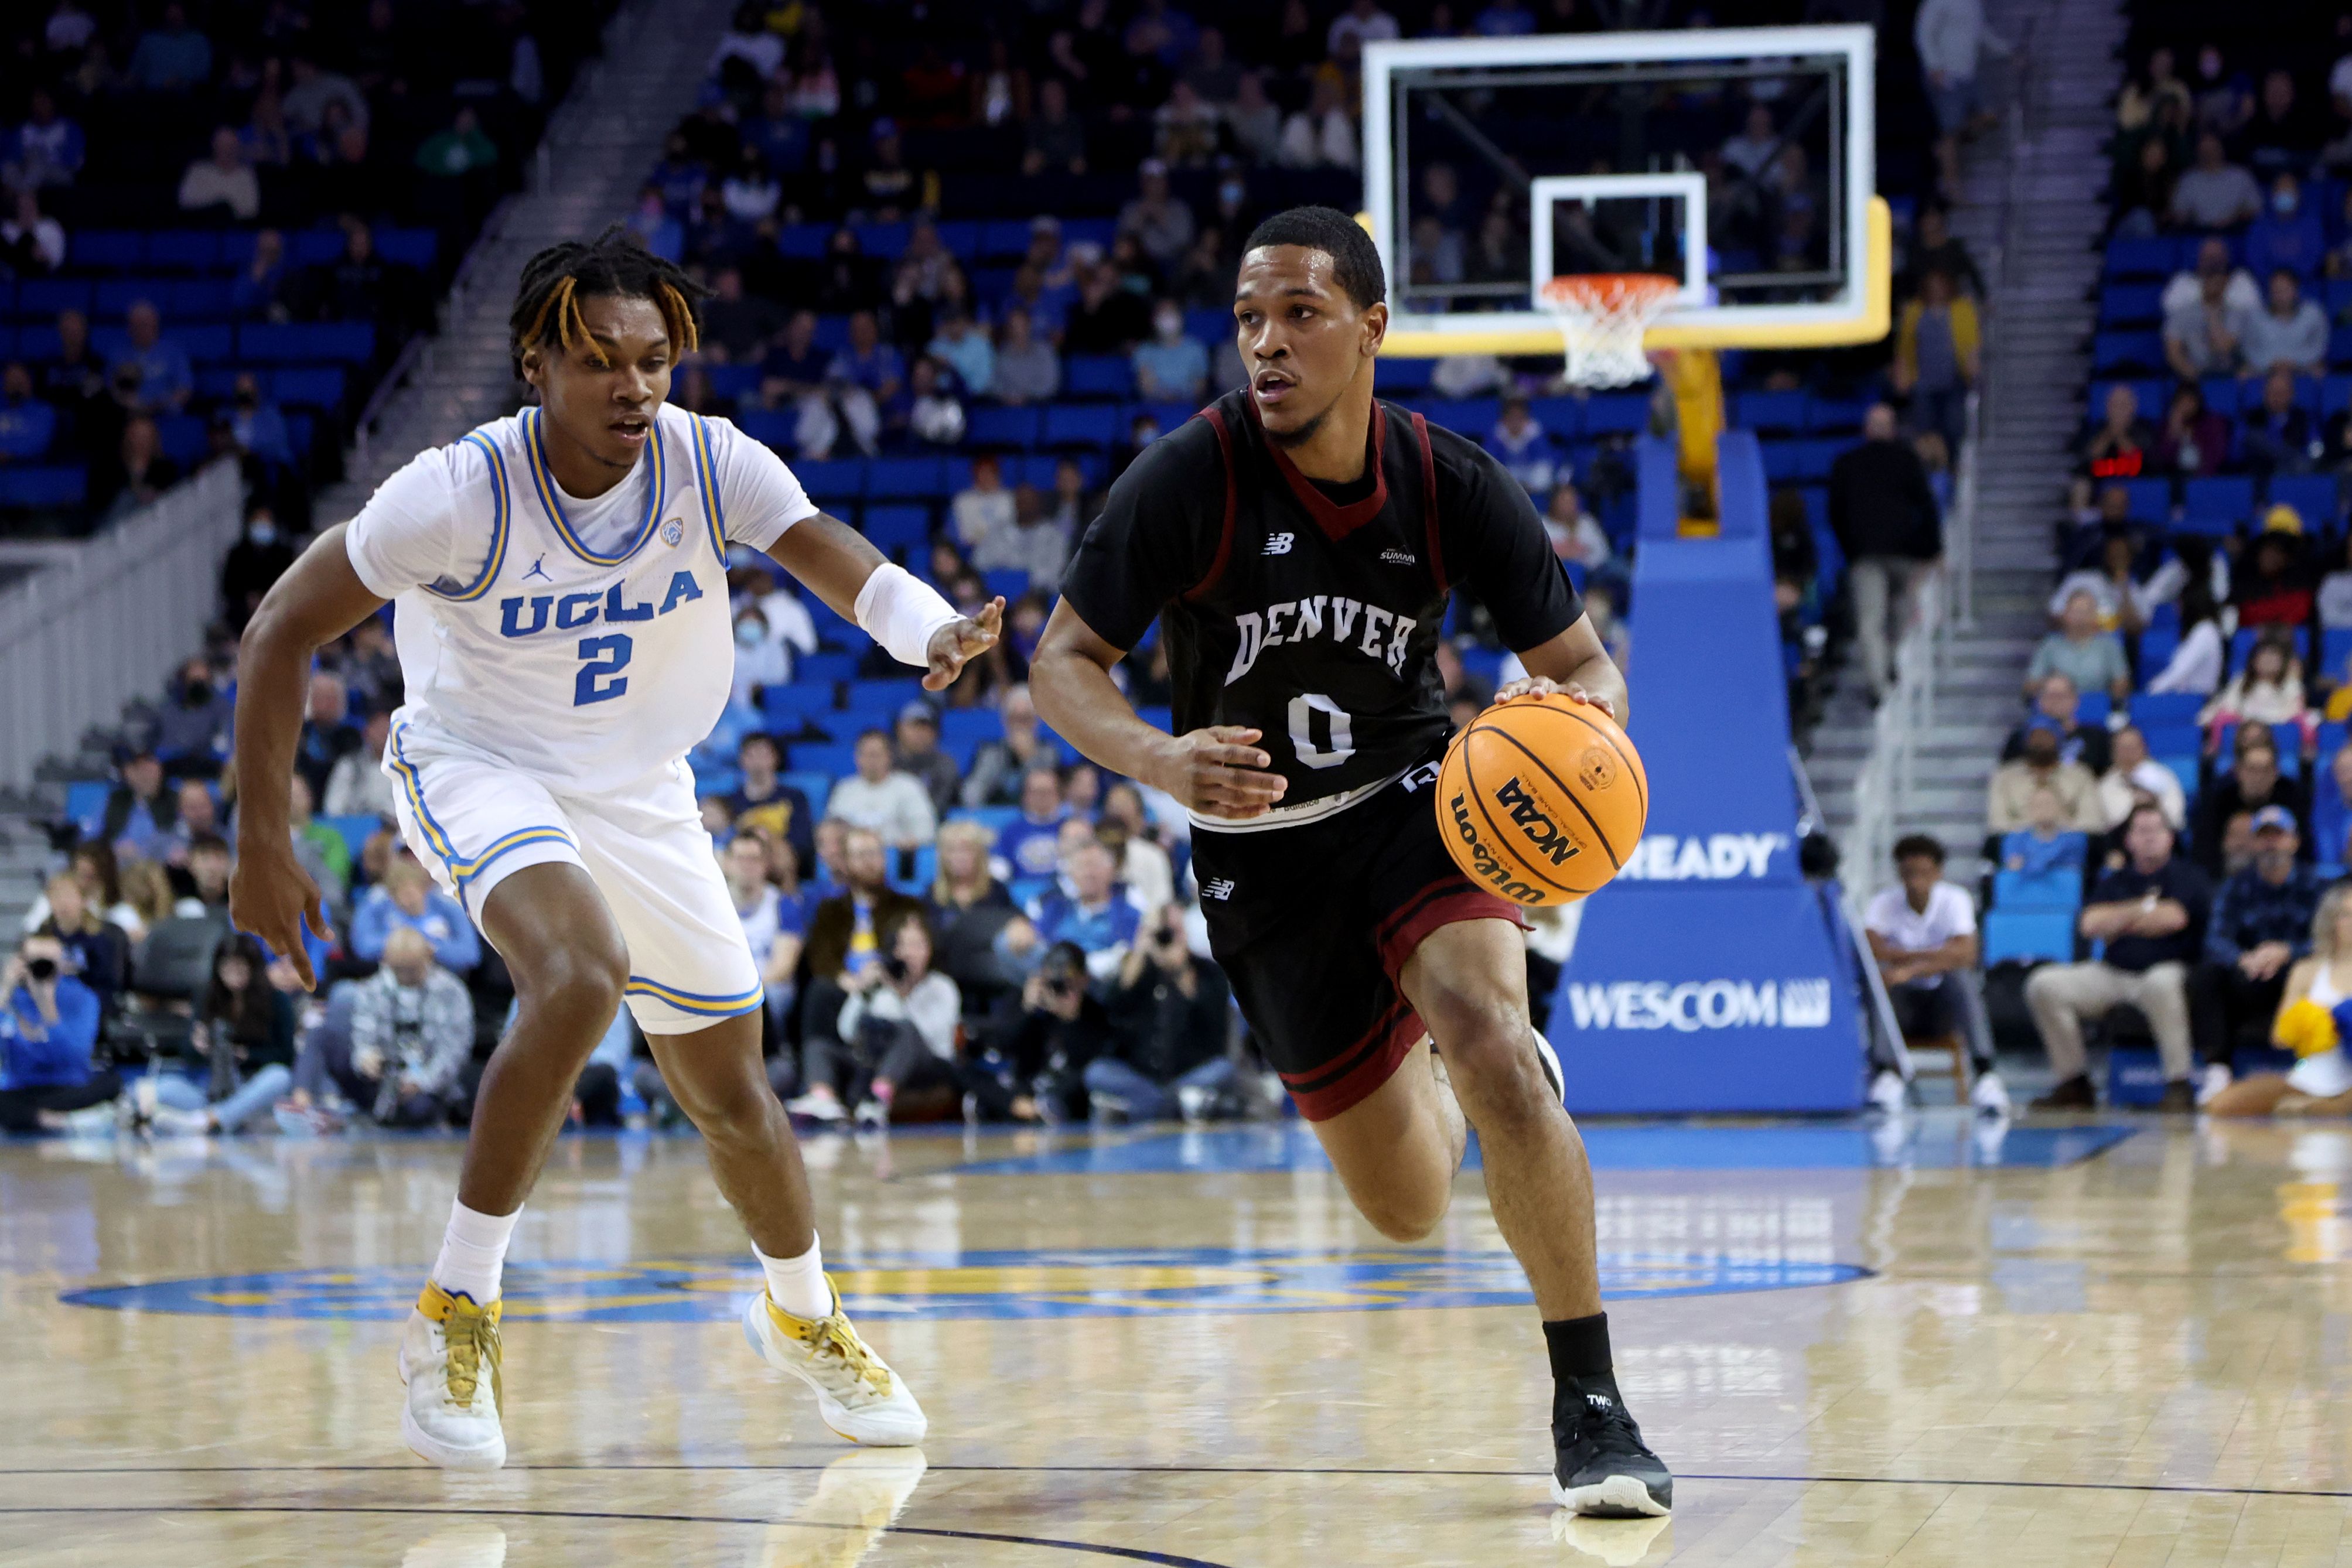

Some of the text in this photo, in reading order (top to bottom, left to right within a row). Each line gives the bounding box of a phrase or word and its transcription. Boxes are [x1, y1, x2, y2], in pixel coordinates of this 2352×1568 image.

[1380, 551, 1415, 563] SUMMI
[500, 570, 704, 638] UCLA
[1224, 595, 1417, 688] DENVER
[573, 633, 633, 708] 2
[1288, 693, 1356, 770] 0
[1450, 790, 1547, 904] Wilson
[1496, 776, 1582, 866] NCAA
[1566, 978, 1778, 1033] WESCOM
